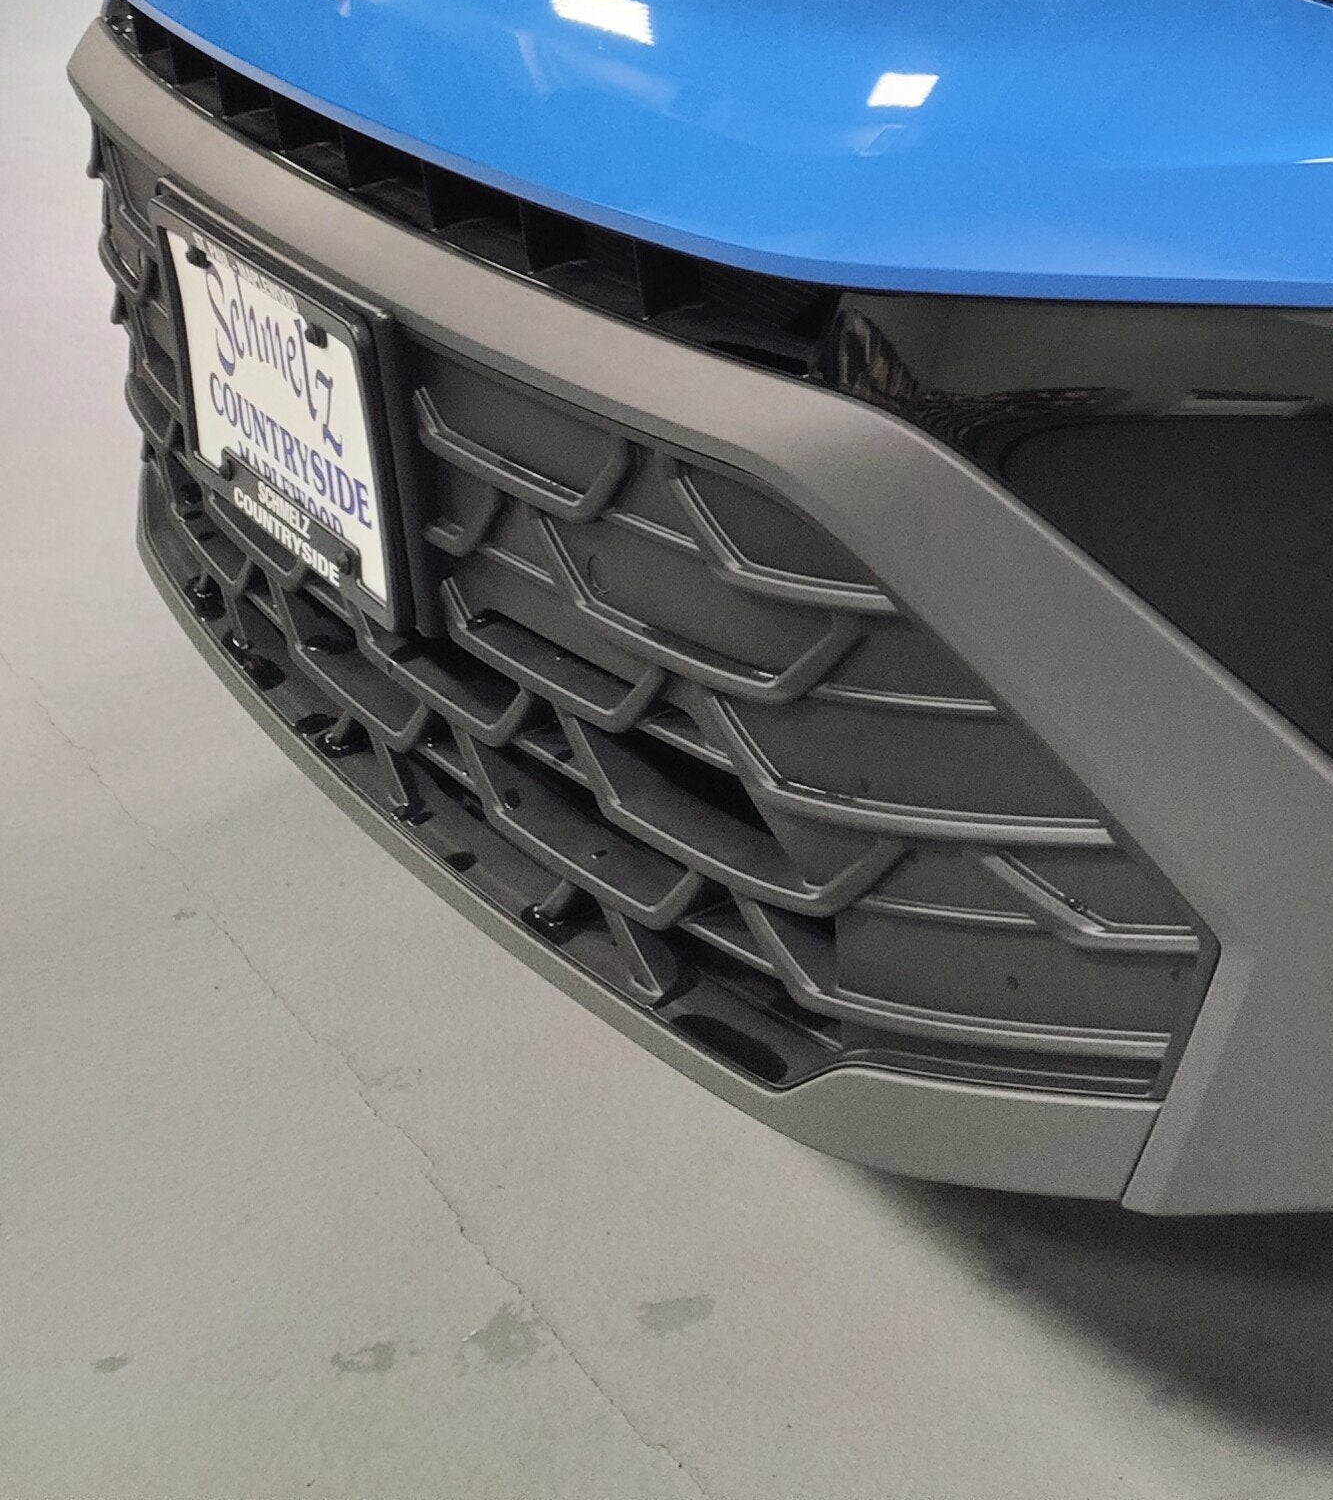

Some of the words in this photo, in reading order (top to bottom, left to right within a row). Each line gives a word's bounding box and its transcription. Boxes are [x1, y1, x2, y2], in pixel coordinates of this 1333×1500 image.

[205, 262, 343, 458] Schmelz
[209, 372, 373, 530] COUNTRYSIDE
[257, 480, 312, 540] SCHMELZ
[233, 486, 341, 588] COUNTRYSIDE
